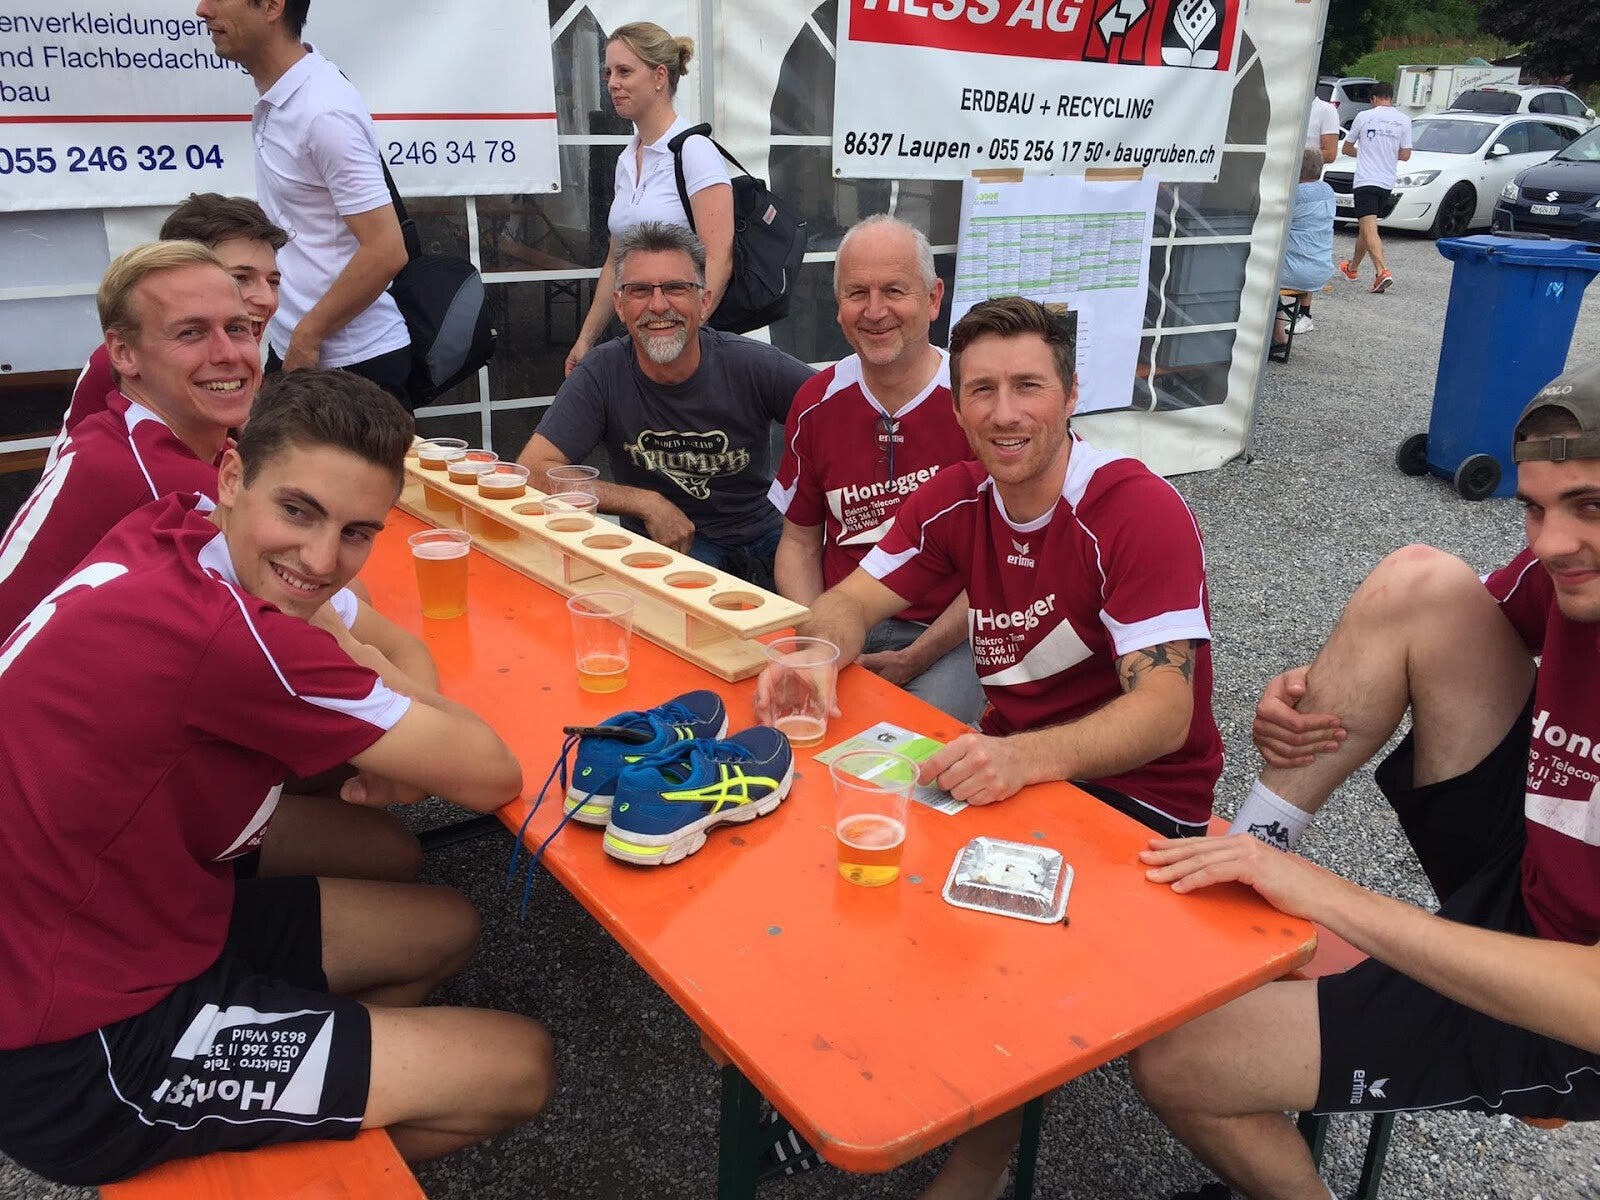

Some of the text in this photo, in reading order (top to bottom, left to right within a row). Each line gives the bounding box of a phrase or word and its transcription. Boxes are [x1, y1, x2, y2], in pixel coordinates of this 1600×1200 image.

[0, 12, 211, 41] enverkleidungen
[0, 46, 33, 68] nd
[0, 80, 51, 102] bau
[960, 88, 1035, 114] ERDBAU
[1057, 95, 1154, 119] RECYCLING
[0, 140, 516, 175] 055 246 32 04 246 34 78
[844, 131, 1216, 168] 8637 Laupen 055 256 17 50 baugruben.ch
[1540, 385, 1573, 397] POLO
[623, 442, 750, 472] TRIUMPH
[842, 464, 940, 505] Honegger
[870, 497, 900, 509] Telecom
[1007, 554, 1035, 568] erima
[989, 645, 1006, 656] 266
[990, 653, 1016, 666] Wald
[1551, 755, 1600, 783] Telecom
[1551, 771, 1569, 787] 33
[232, 1029, 307, 1044] 8636 Wald
[241, 1043, 269, 1057] 266
[273, 1044, 300, 1058] 055
[240, 1058, 291, 1073] Elektro
[1350, 1069, 1368, 1104] erima
